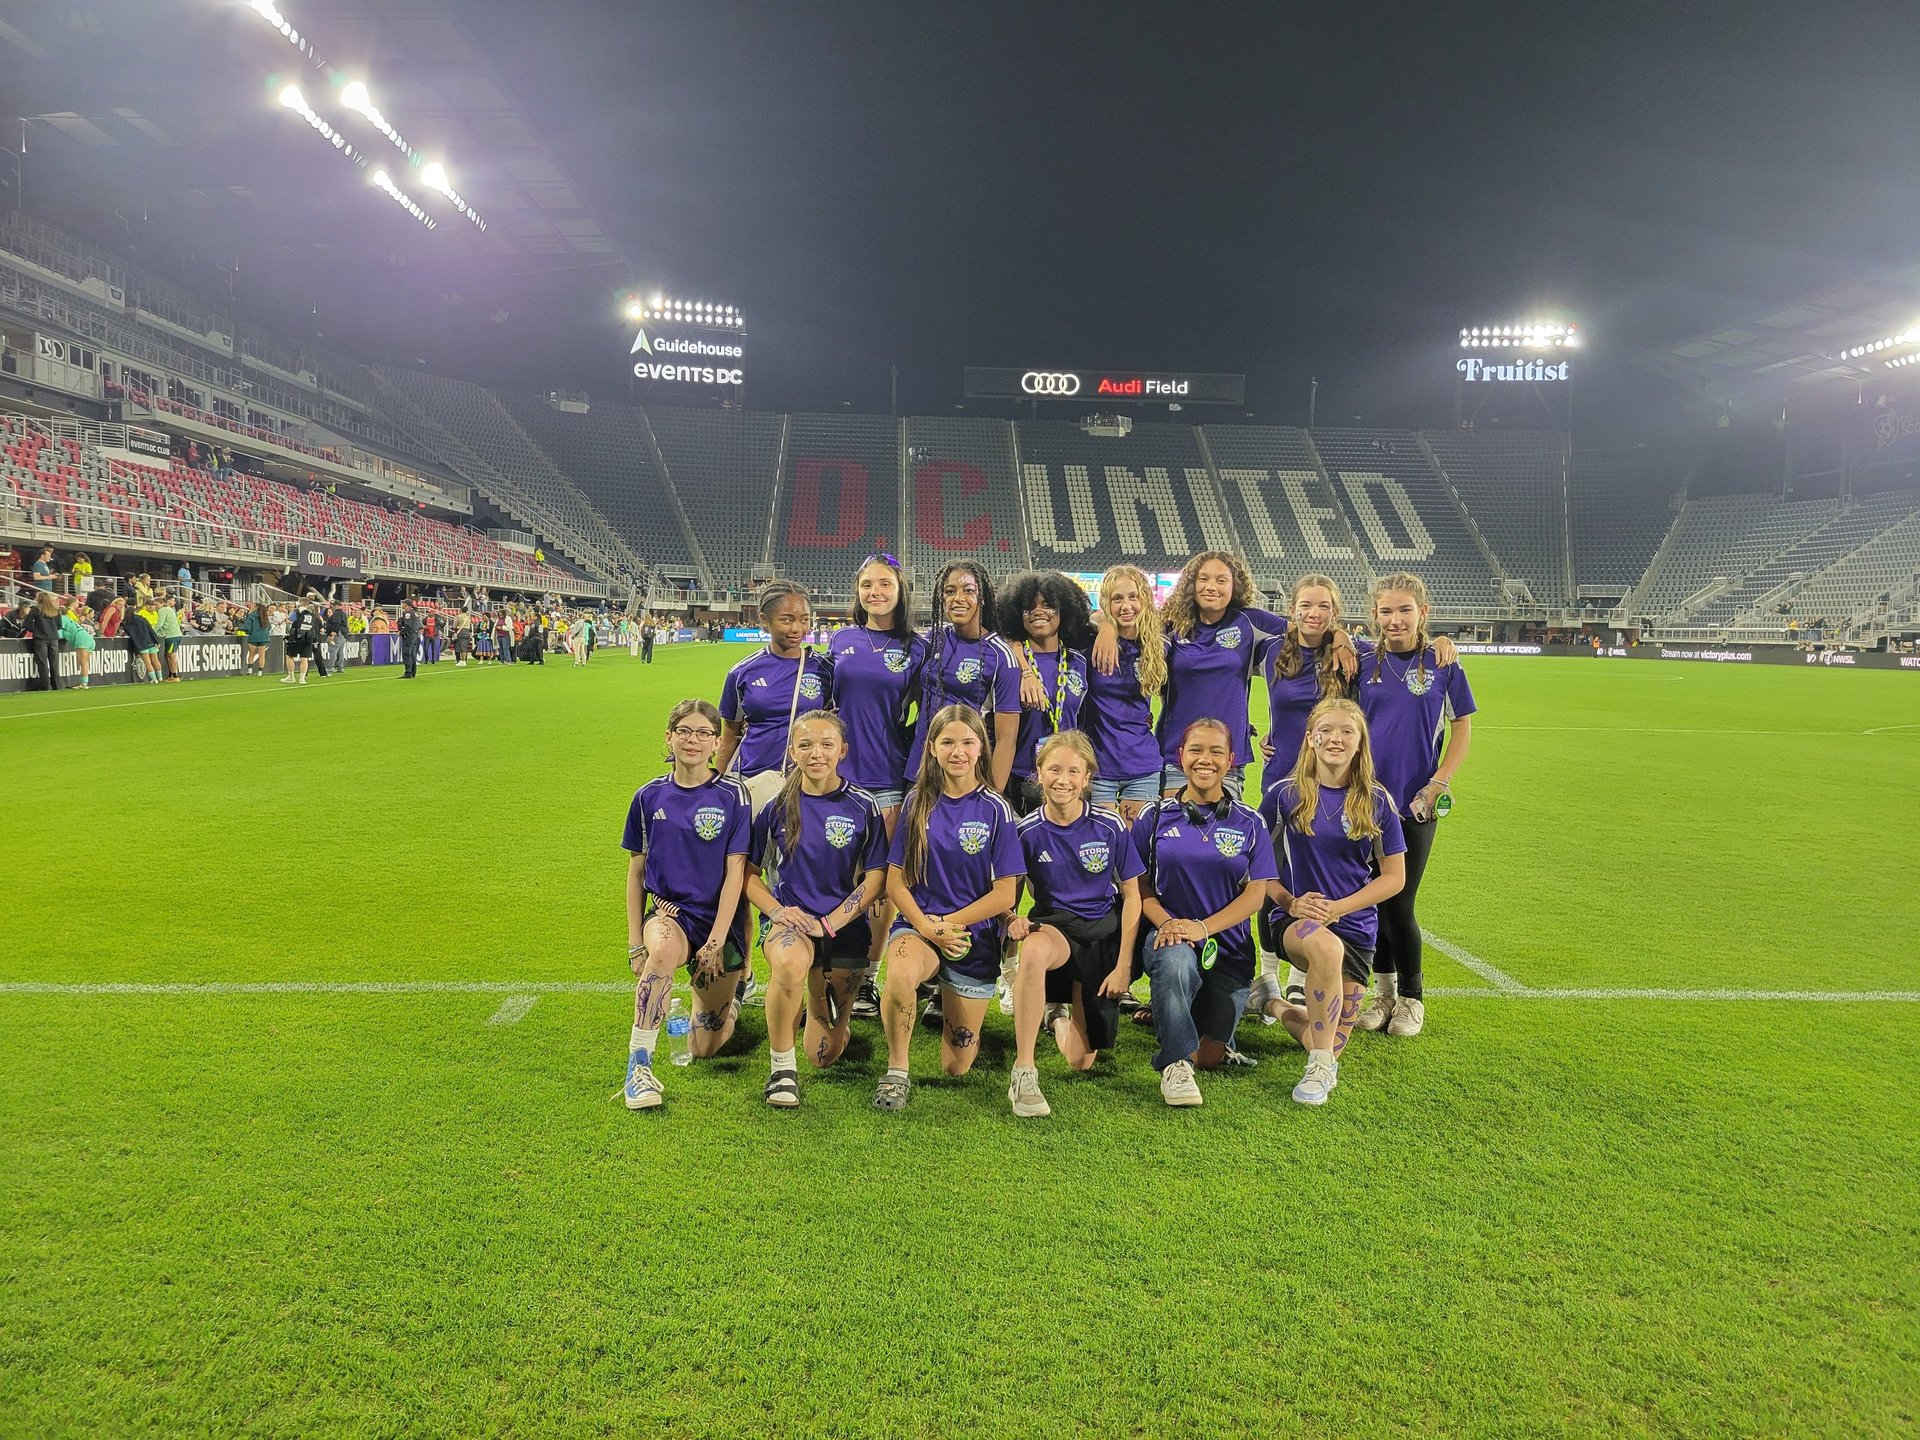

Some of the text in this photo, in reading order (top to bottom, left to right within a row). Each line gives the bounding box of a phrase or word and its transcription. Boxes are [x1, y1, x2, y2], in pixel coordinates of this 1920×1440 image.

[653, 338, 742, 357] Guidehouse
[1456, 358, 1569, 381] Fruitist
[716, 368, 743, 384] DC
[1098, 379, 1188, 394] Audi Field
[157, 446, 170, 456] CLUB
[1023, 463, 1437, 561] UNITED
[326, 555, 356, 569] Audi Field
[1468, 645, 1486, 653] FREE
[1486, 645, 1498, 653] ON
[177, 644, 242, 673] NIKE SOCCER
[1661, 649, 1681, 658] Stream
[1693, 651, 1700, 659] at
[1700, 650, 1752, 662] victoryplus.com
[1833, 654, 1856, 664] NWSL
[694, 813, 725, 822] STORM
[825, 821, 856, 830] STORM
[958, 827, 990, 837] STORM
[1213, 832, 1245, 842] STORM
[1079, 847, 1110, 857] STORM
